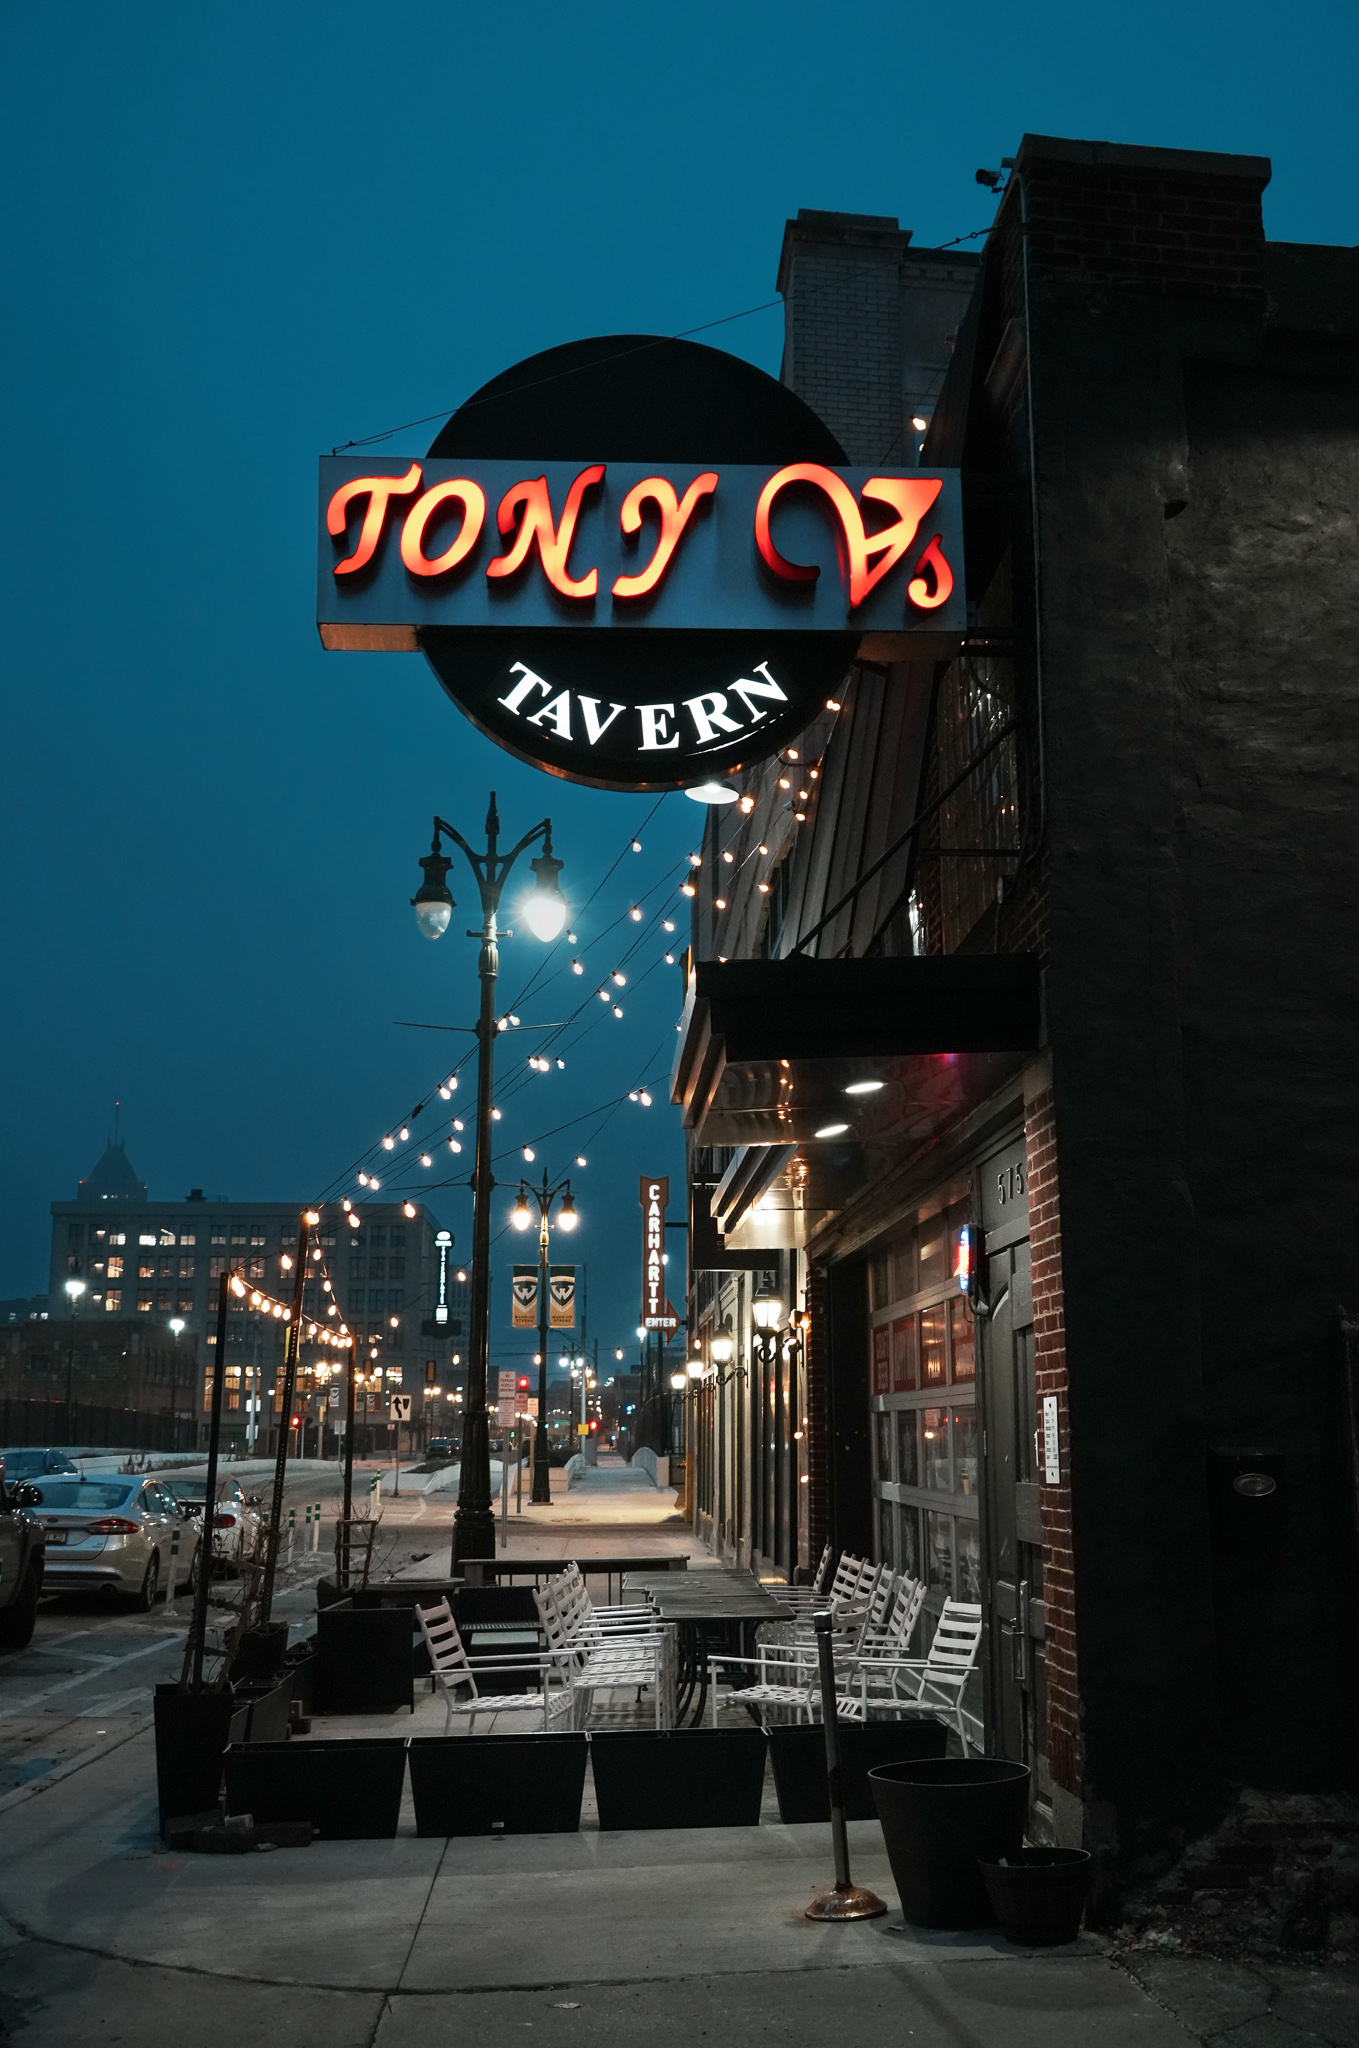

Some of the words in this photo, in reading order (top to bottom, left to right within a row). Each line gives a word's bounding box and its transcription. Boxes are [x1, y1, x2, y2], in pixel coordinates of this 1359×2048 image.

[326, 462, 719, 600] TONY
[497, 660, 789, 753] TAVERN
[997, 1163, 1025, 1205] 575
[648, 1184, 661, 1315] CARHARTT
[645, 1317, 676, 1328] ENTER
